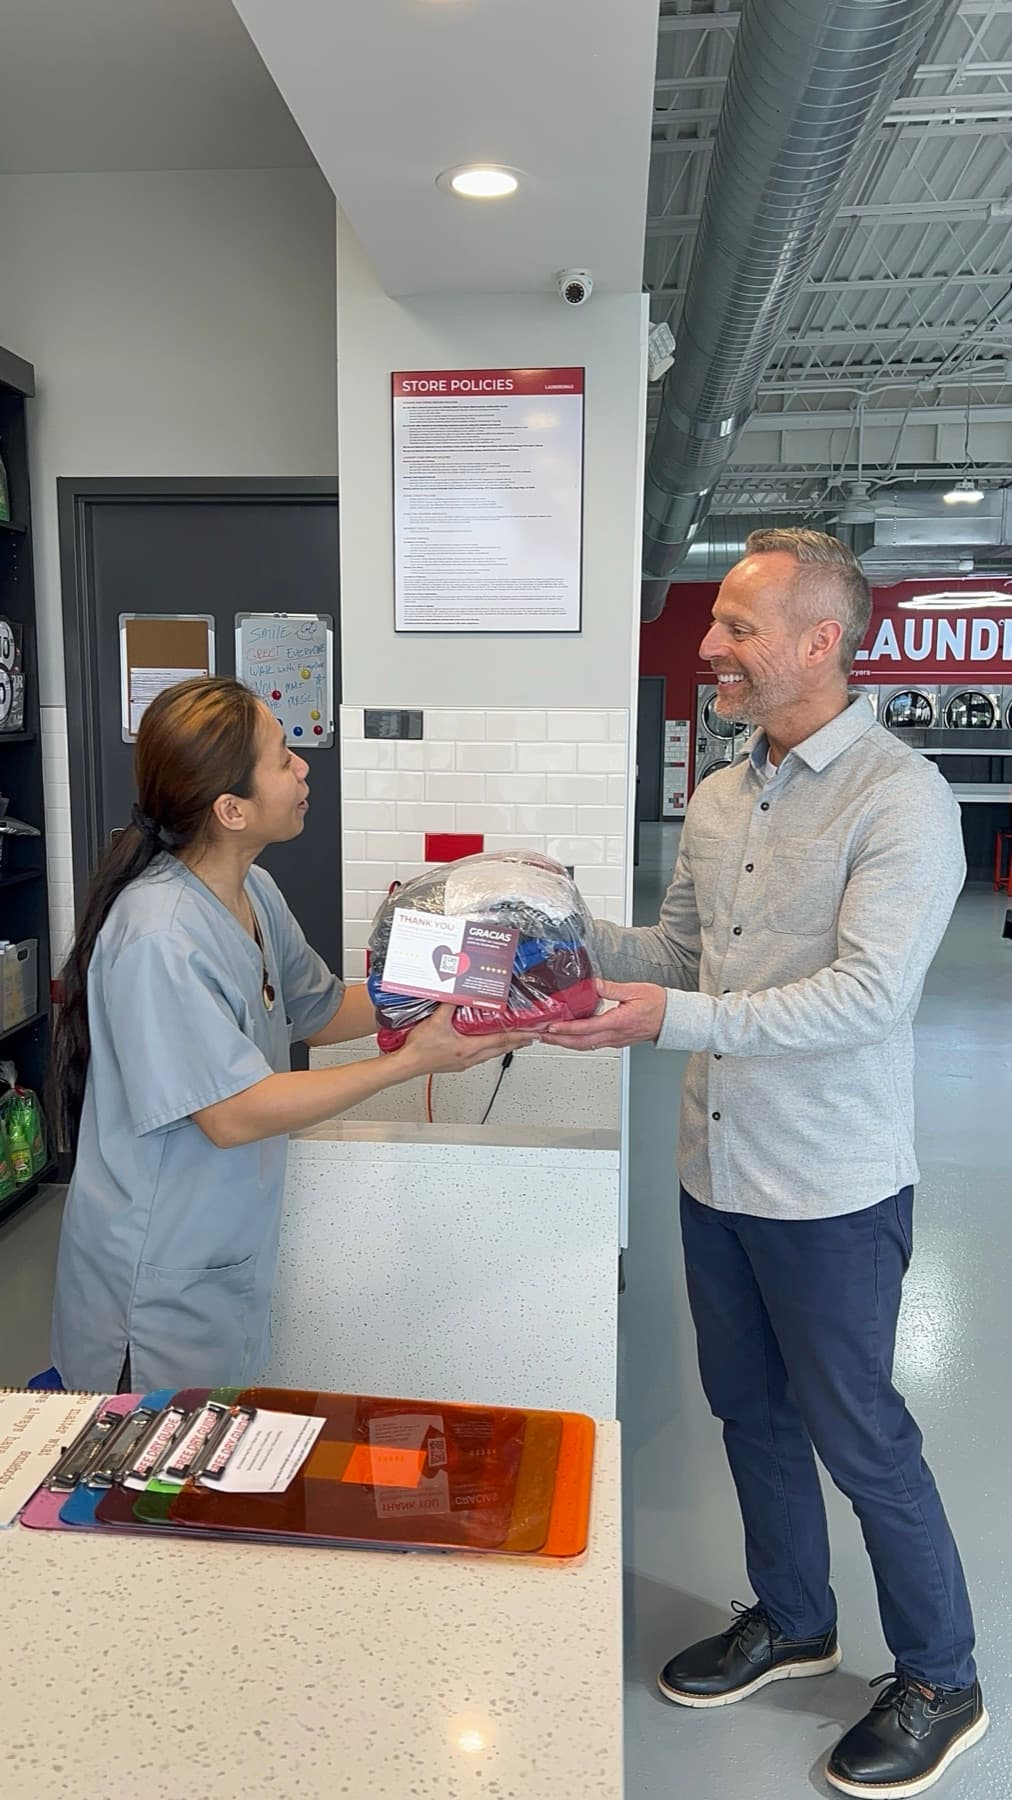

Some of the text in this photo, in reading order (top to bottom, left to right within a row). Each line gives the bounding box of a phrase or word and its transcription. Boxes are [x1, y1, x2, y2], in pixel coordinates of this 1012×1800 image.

[402, 378, 514, 392] STORE POLICIES
[855, 618, 1012, 661] AUND
[399, 914, 455, 931] THANK YOU
[468, 927, 512, 942] GRACIAS
[188, 1435, 202, 1452] DRY
[198, 1412, 218, 1437] GUIDE
[137, 1417, 179, 1475] REE DRY GUIDE
[224, 1437, 236, 1455] DRY
